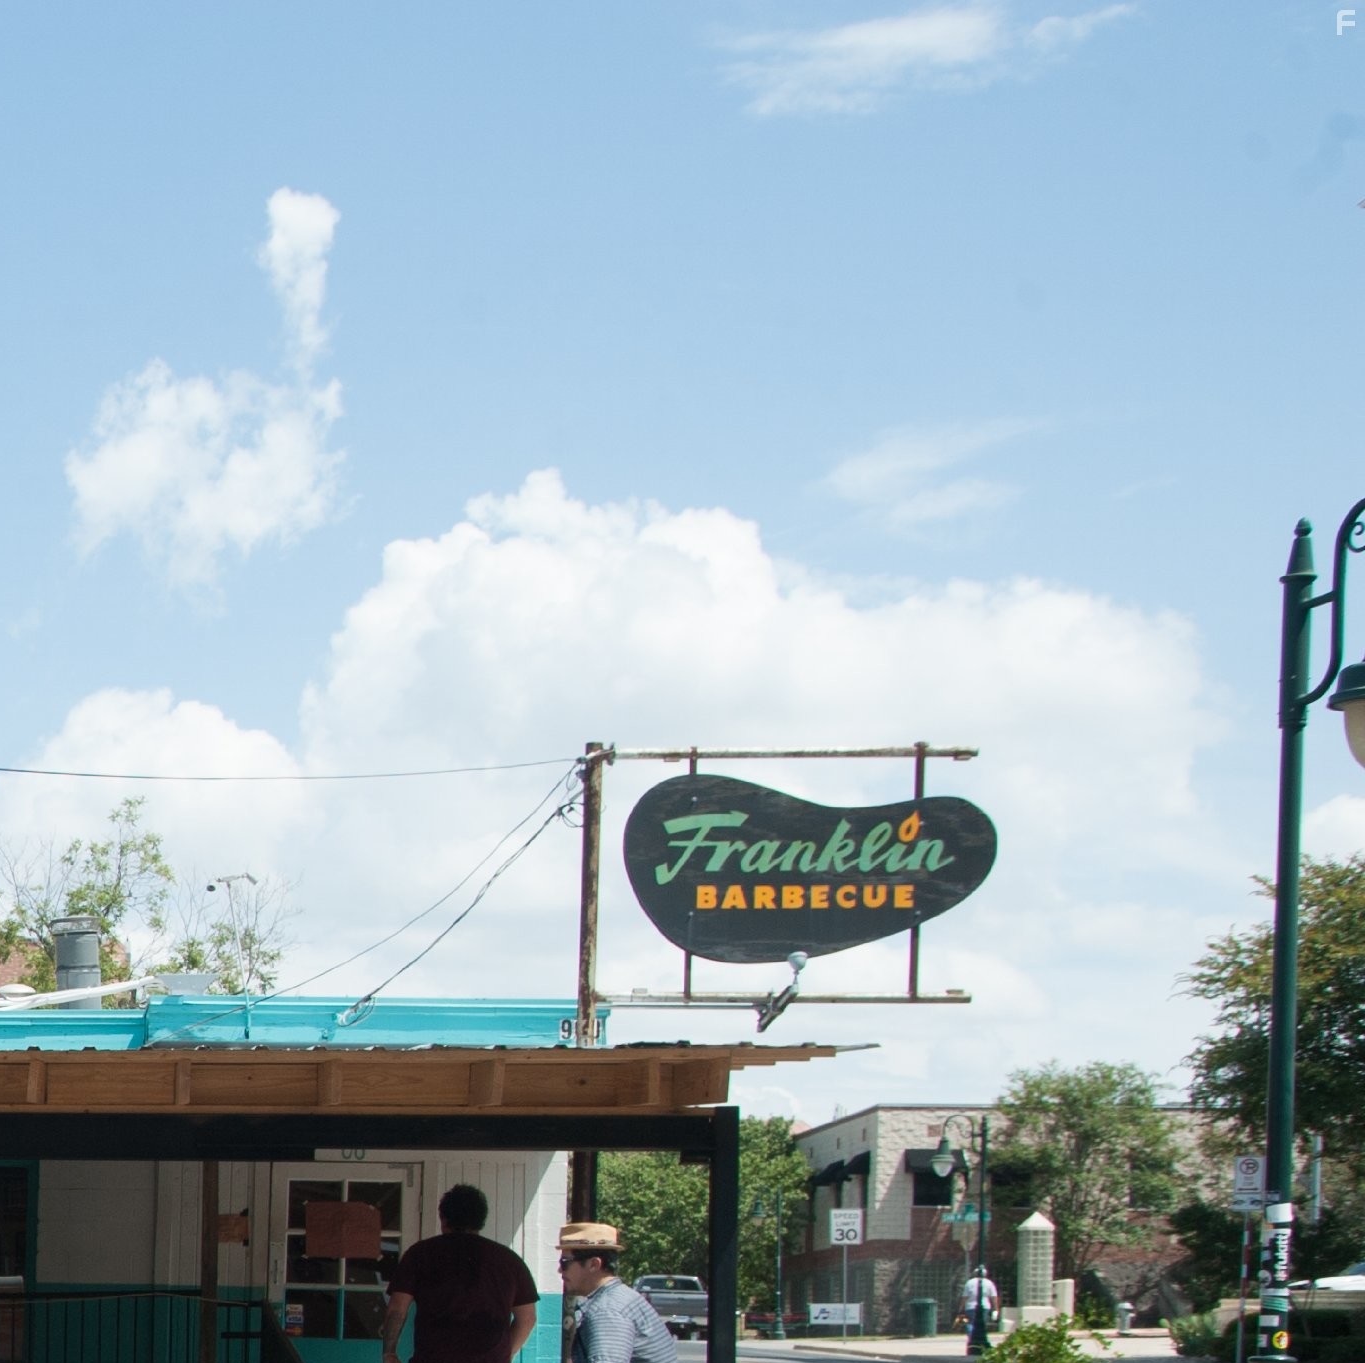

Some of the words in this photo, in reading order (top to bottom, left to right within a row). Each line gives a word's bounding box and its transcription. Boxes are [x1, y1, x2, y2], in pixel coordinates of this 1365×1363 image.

[655, 811, 956, 885] Franklin
[696, 884, 916, 910] BARBECUE
[834, 1228, 858, 1241] 30
